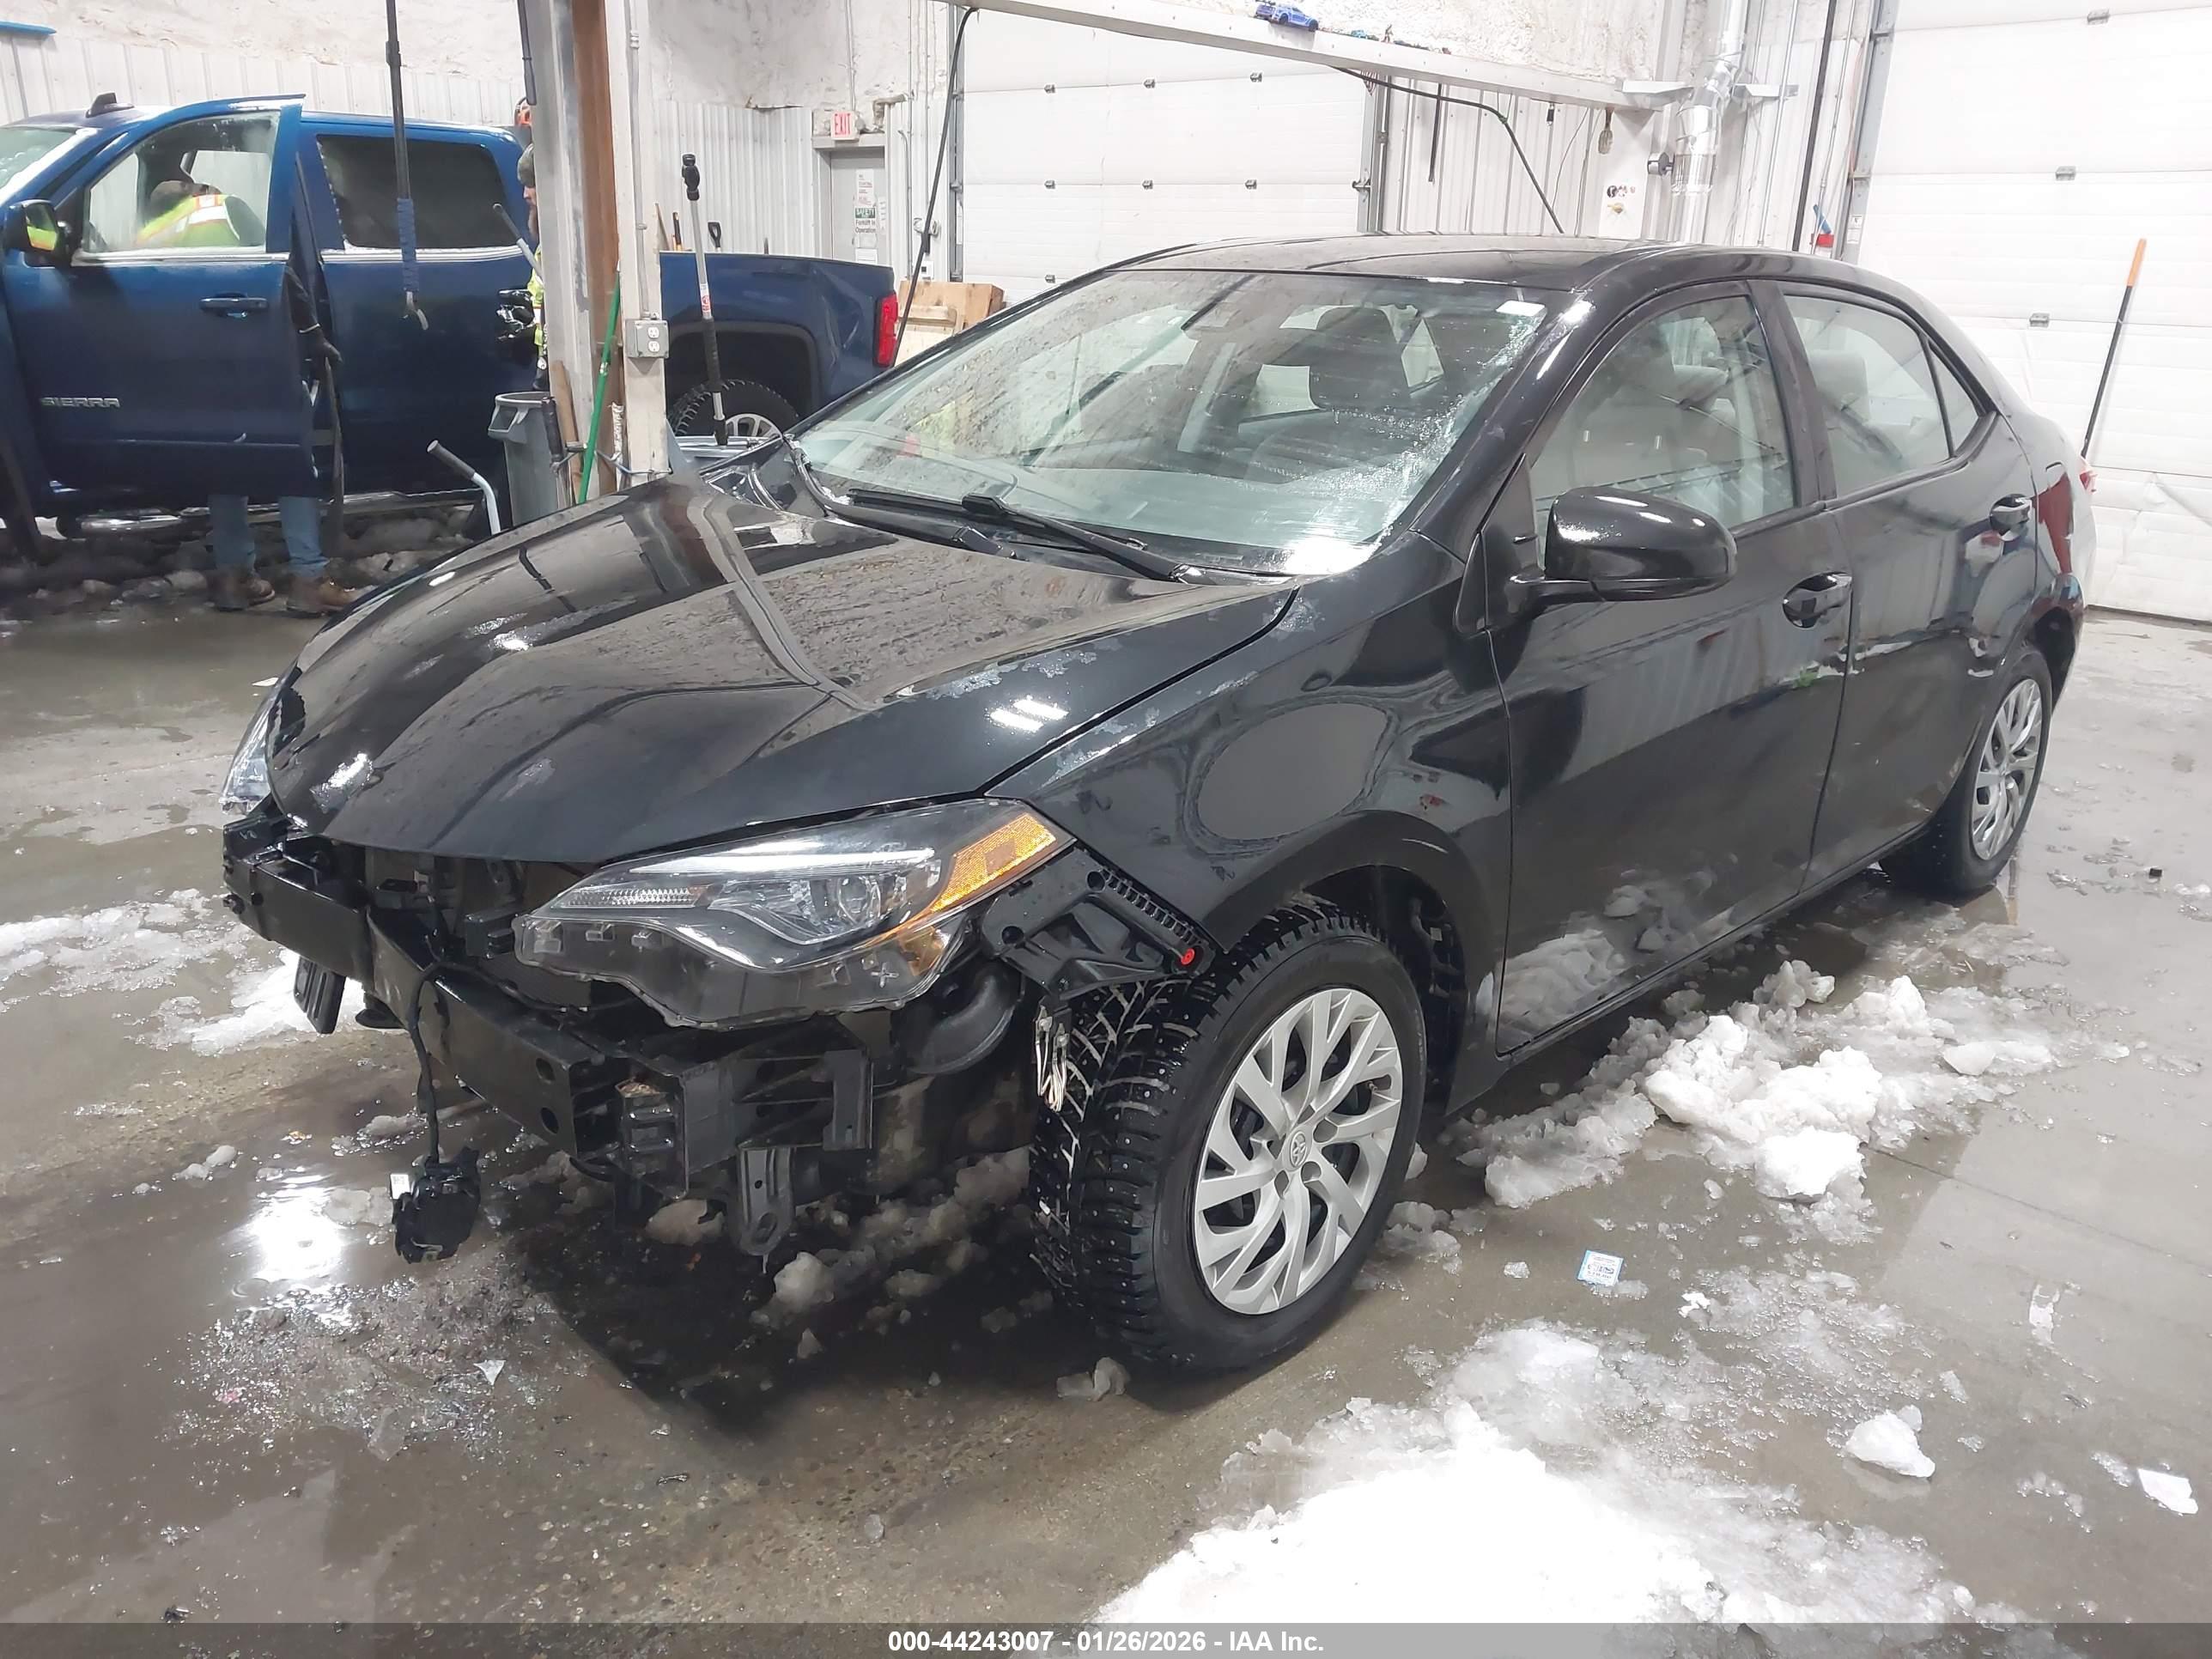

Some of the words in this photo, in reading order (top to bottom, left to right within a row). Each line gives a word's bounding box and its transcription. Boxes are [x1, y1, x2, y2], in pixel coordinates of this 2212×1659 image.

[835, 113, 850, 135] EXIT
[856, 207, 875, 216] SAFETY
[41, 397, 120, 408] SIERRA
